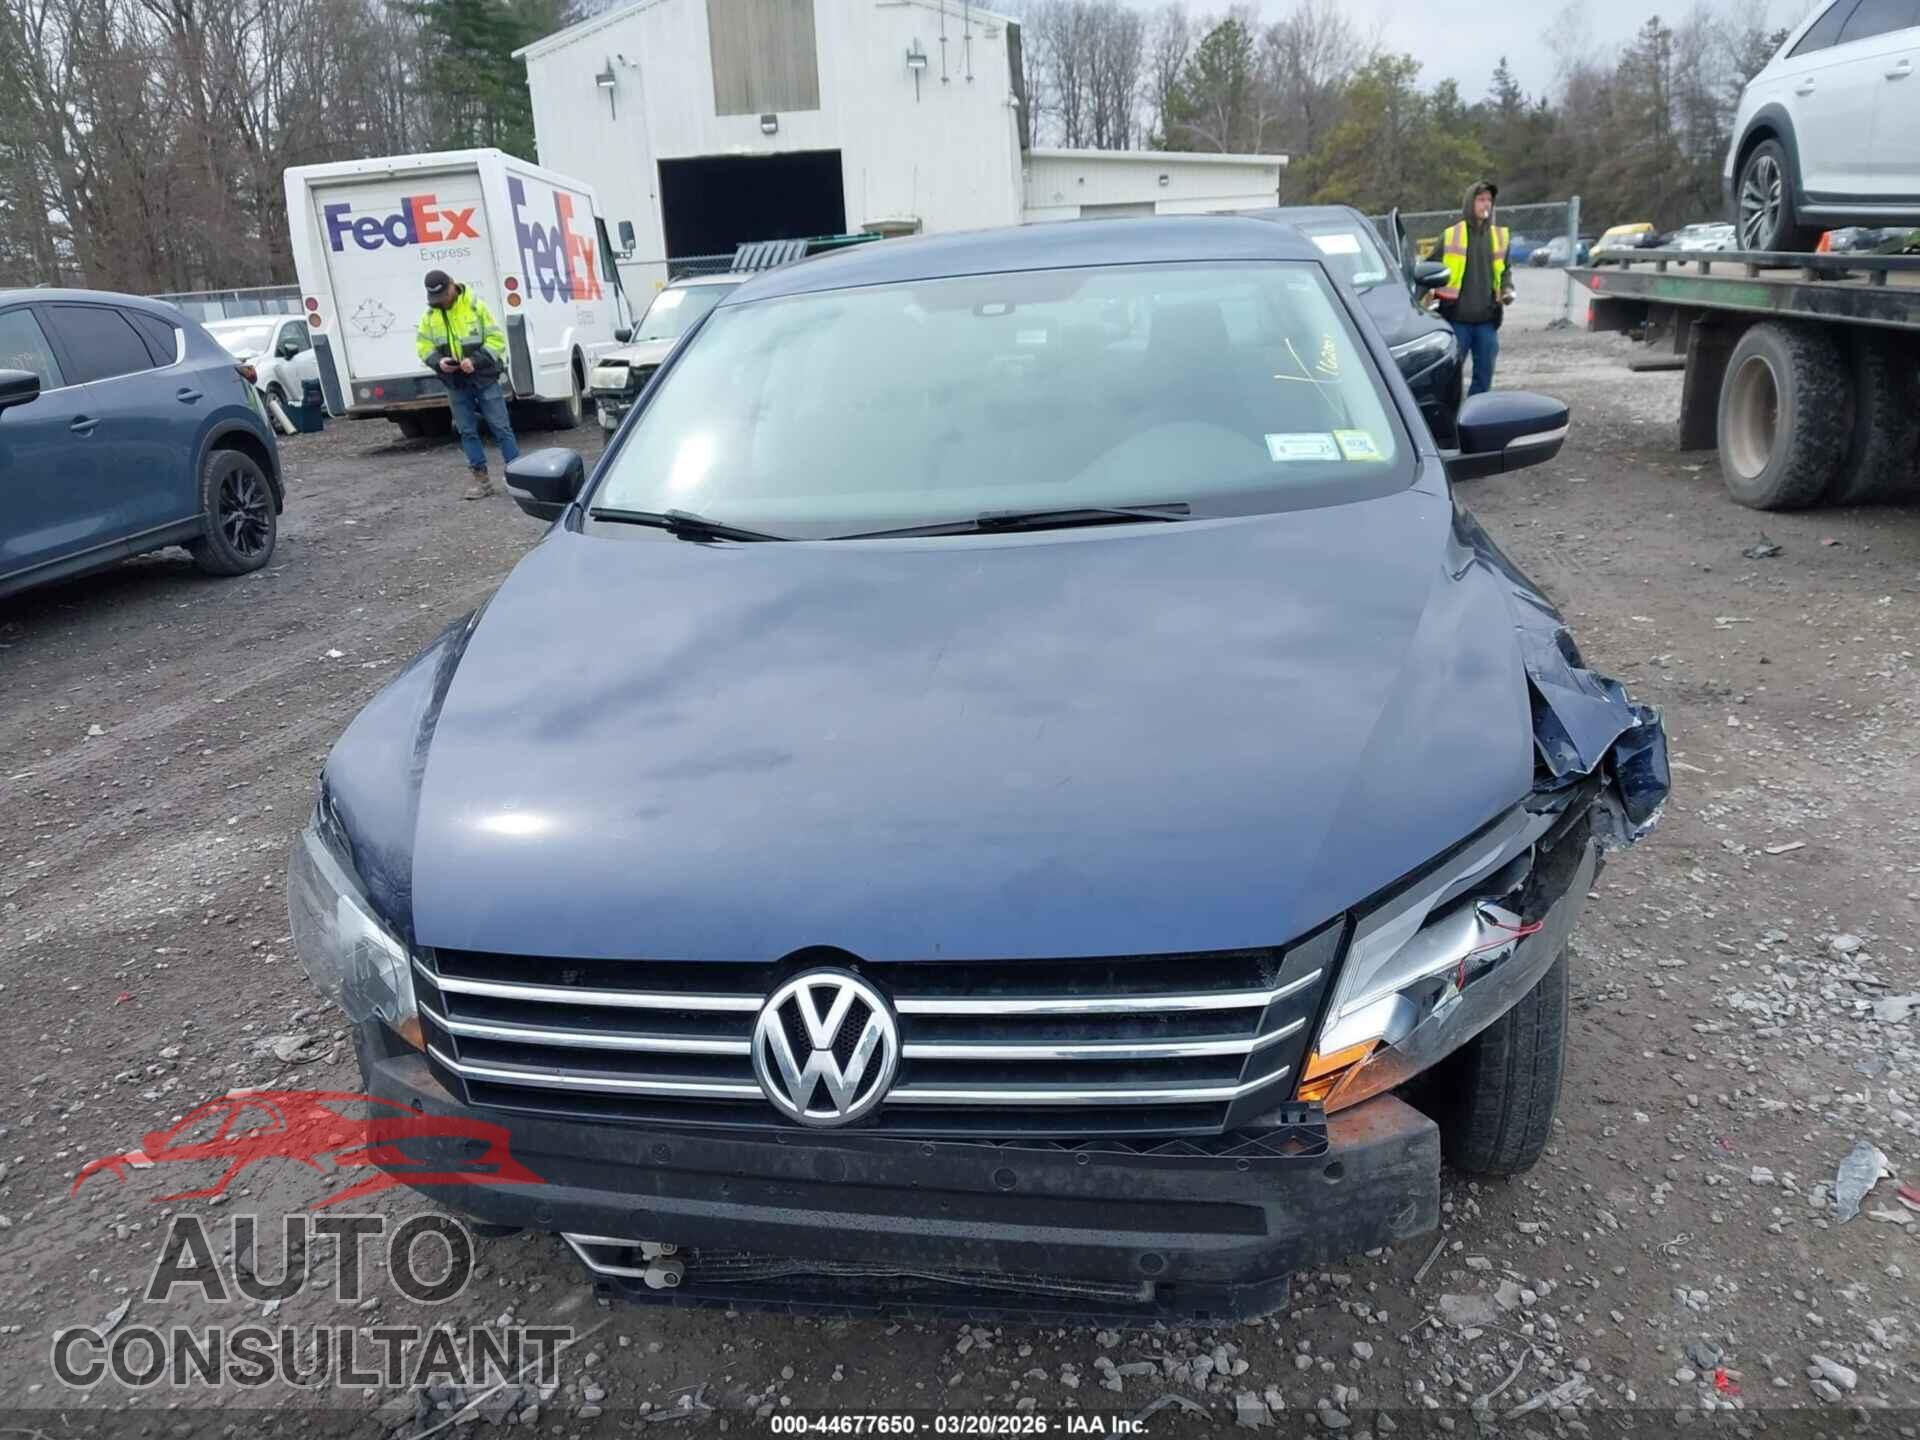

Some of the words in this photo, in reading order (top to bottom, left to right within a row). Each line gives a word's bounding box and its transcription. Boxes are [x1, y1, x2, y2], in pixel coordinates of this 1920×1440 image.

[324, 194, 480, 252] FedEx
[507, 175, 602, 304] FedEx
[419, 246, 471, 262] Express
